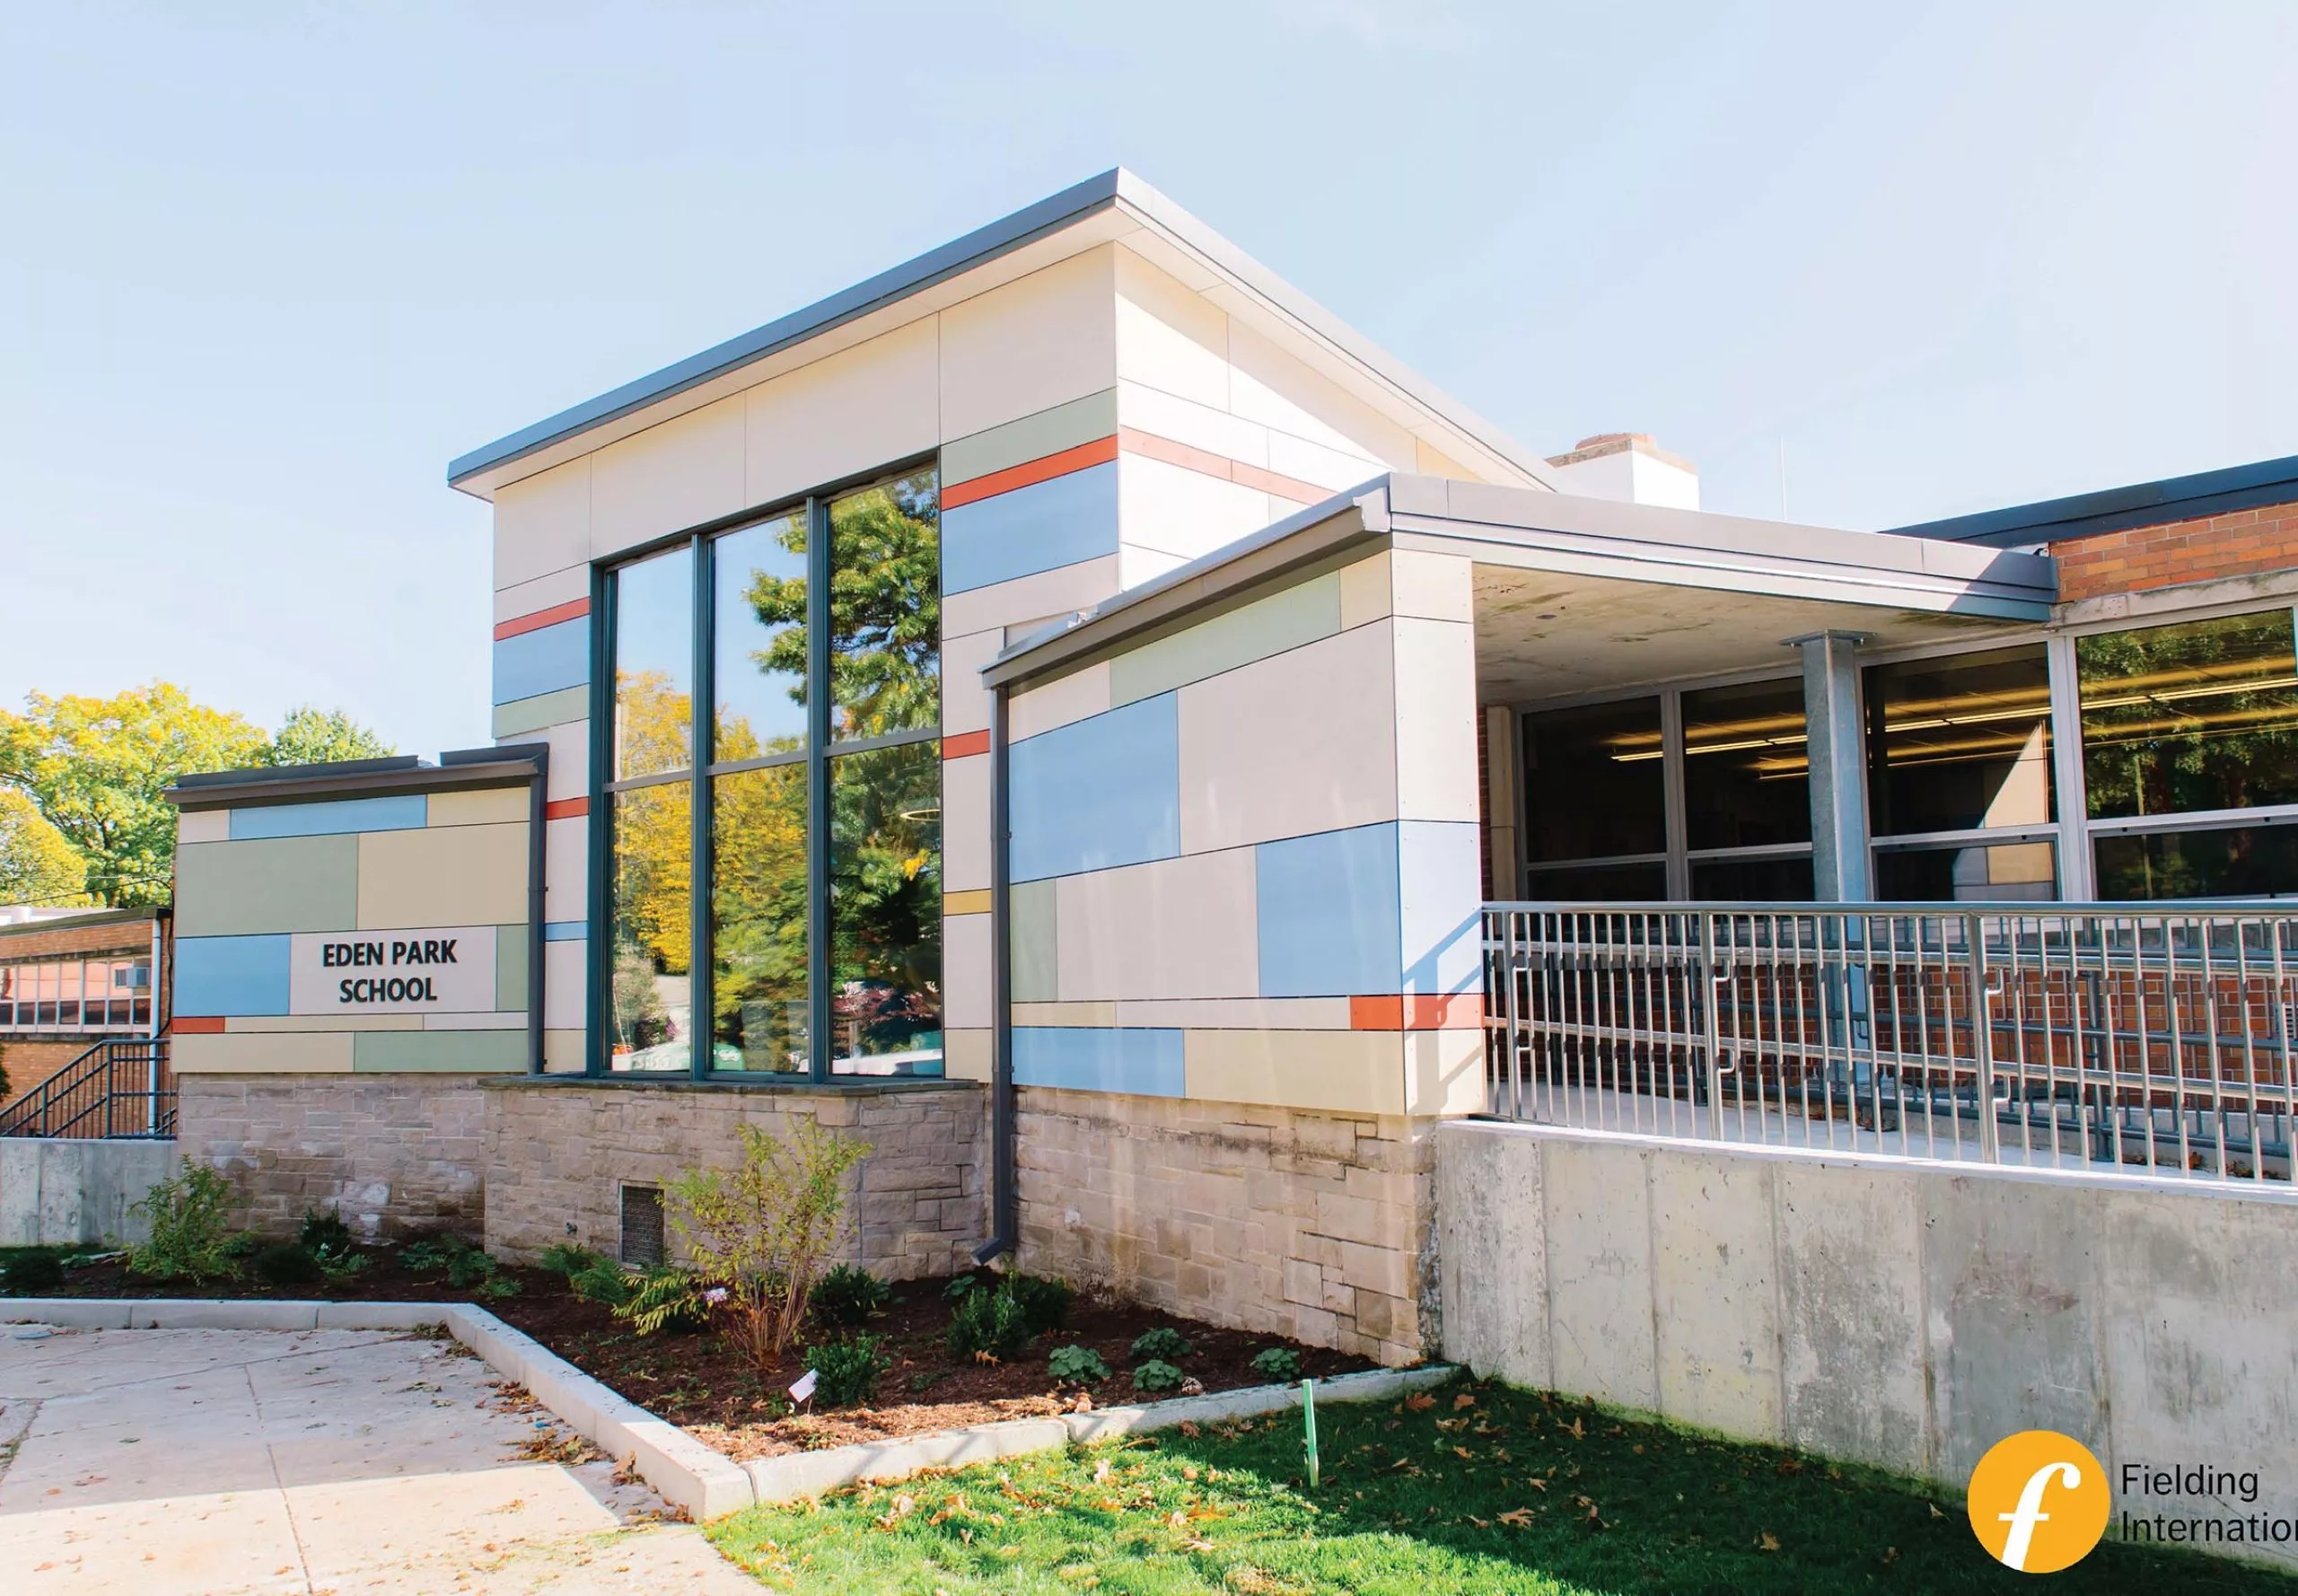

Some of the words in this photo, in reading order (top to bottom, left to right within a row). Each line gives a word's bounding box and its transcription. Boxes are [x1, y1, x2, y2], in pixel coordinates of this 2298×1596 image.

[322, 942, 384, 968] EDEN
[391, 939, 458, 966] PARK
[339, 977, 438, 1004] SCHOOL
